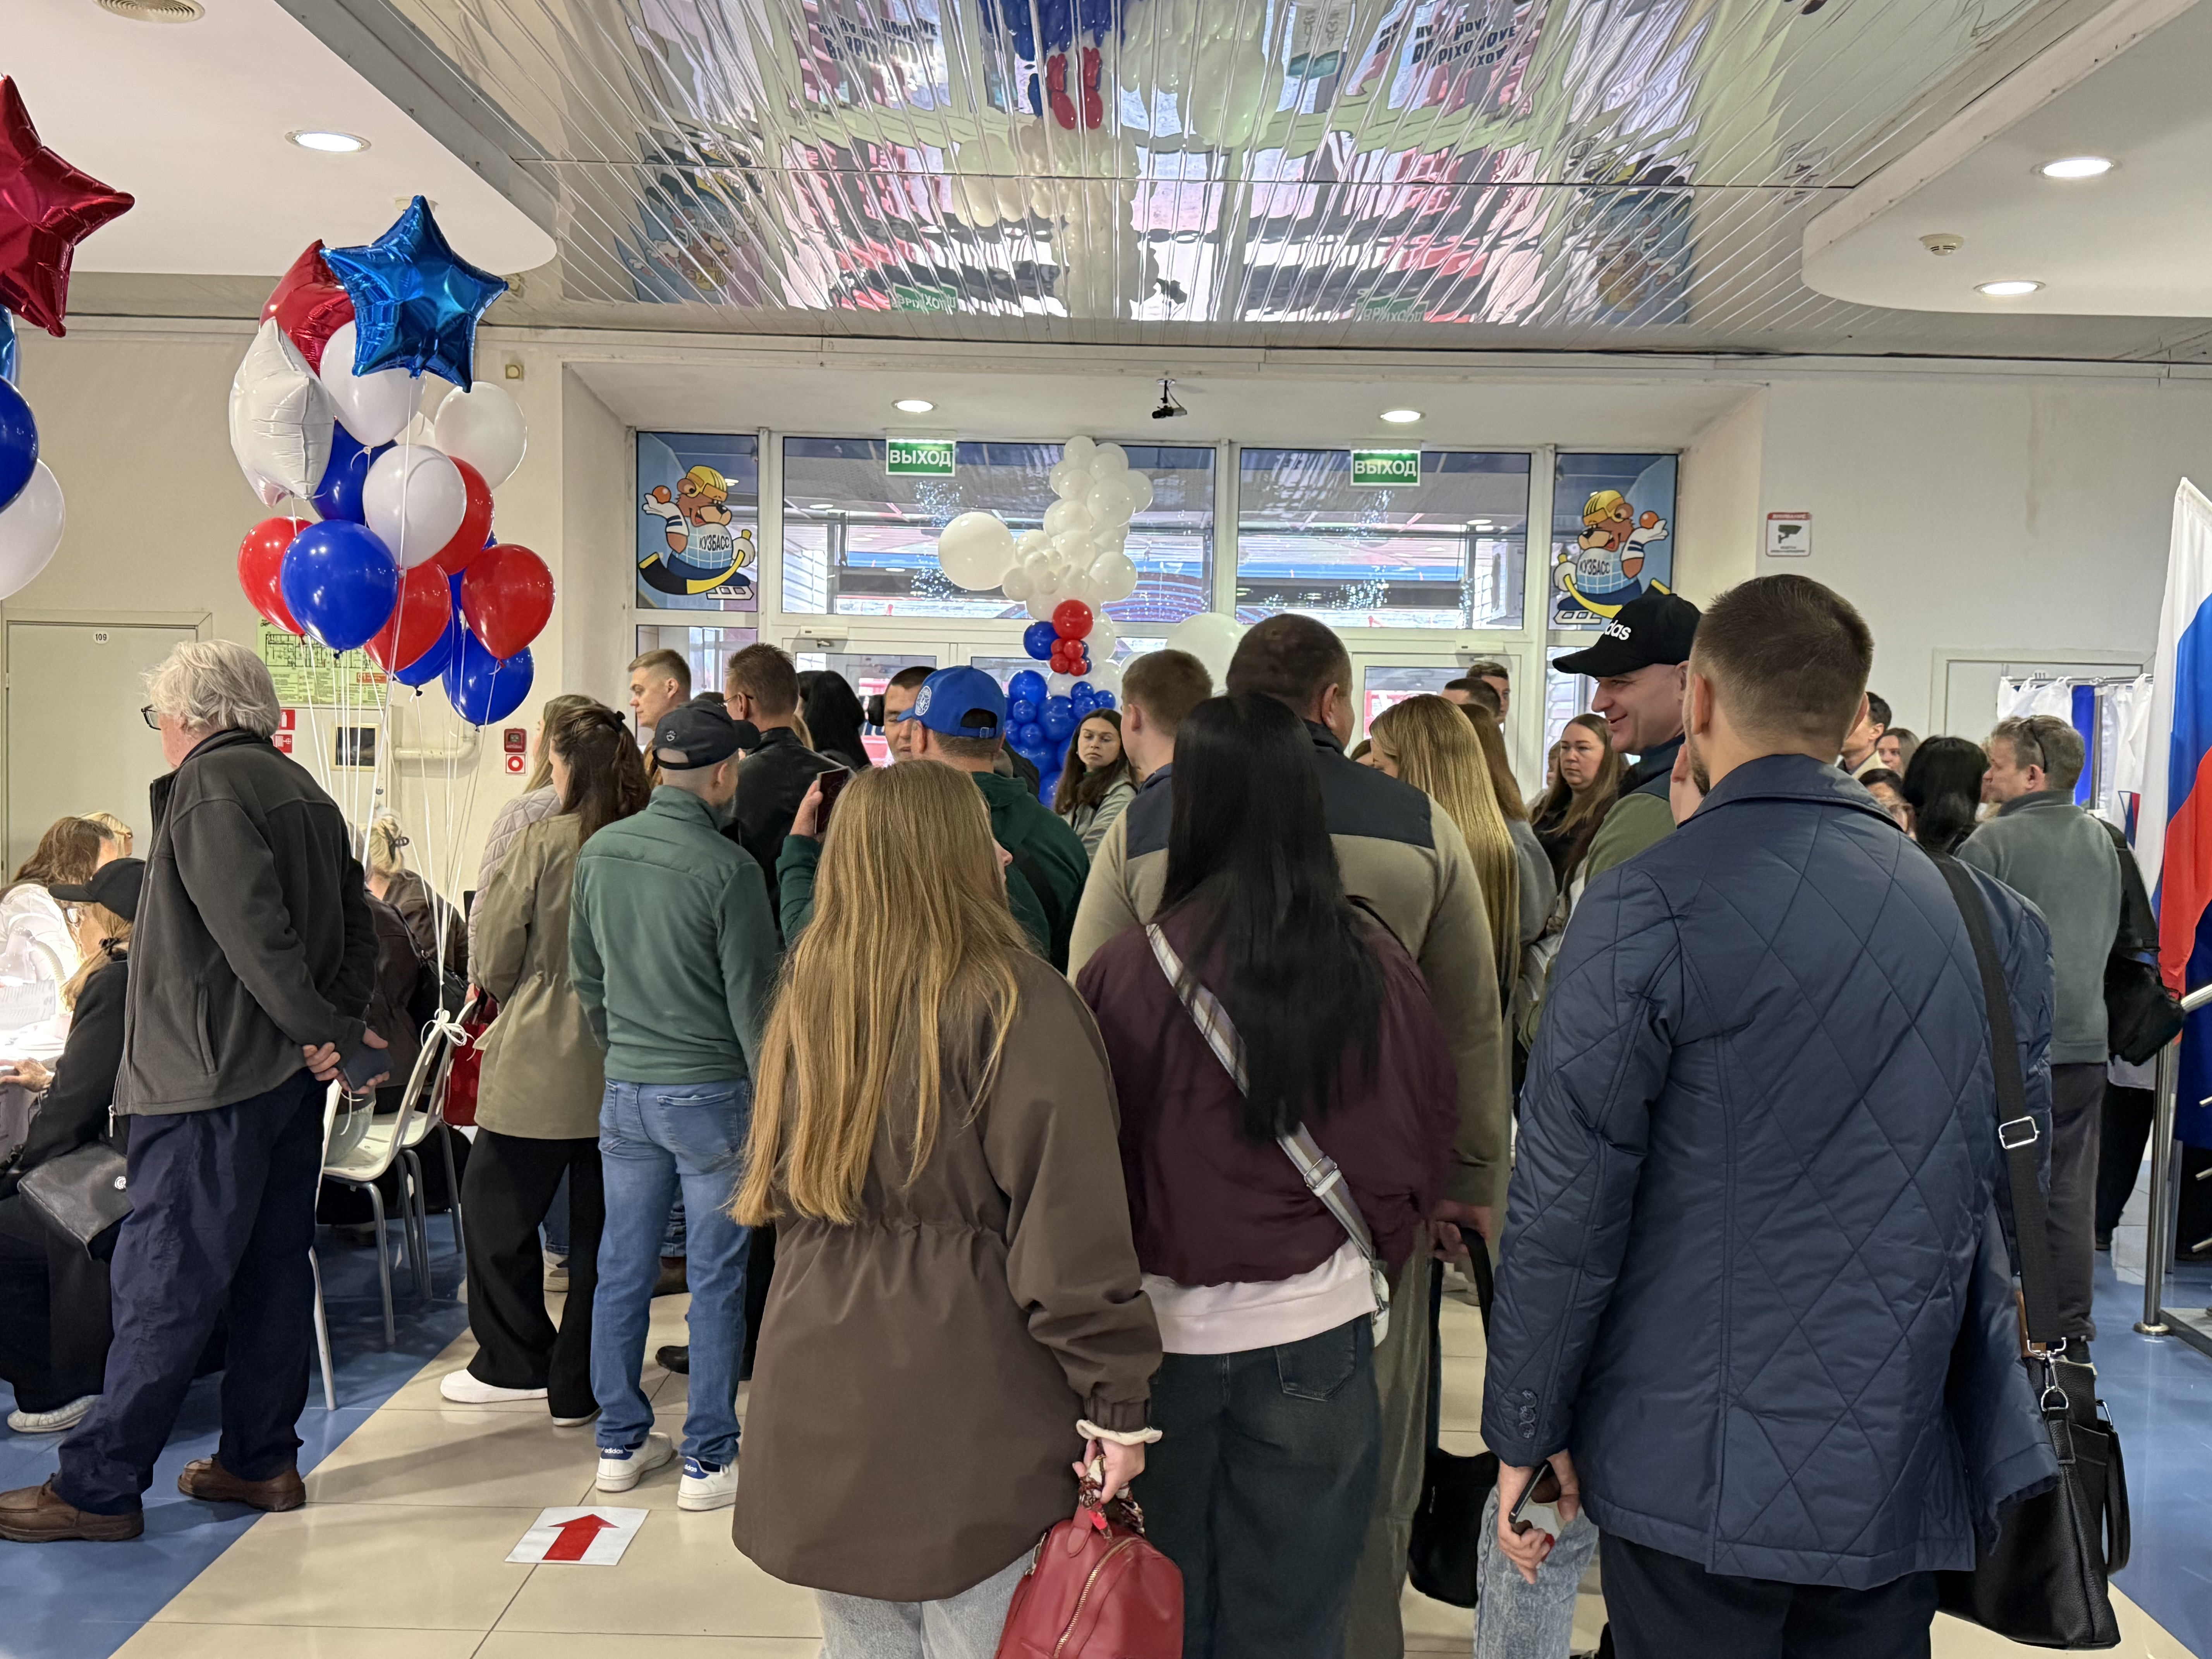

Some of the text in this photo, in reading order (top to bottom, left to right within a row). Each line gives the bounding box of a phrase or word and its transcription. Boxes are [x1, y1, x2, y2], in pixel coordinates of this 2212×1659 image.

[890, 450, 951, 467] ВЫХОД
[1355, 460, 1417, 477] ВЫХОД
[699, 534, 730, 551] КУЗБАСС
[1579, 558, 1610, 575] КУЗБАСС
[1604, 620, 1632, 640] das
